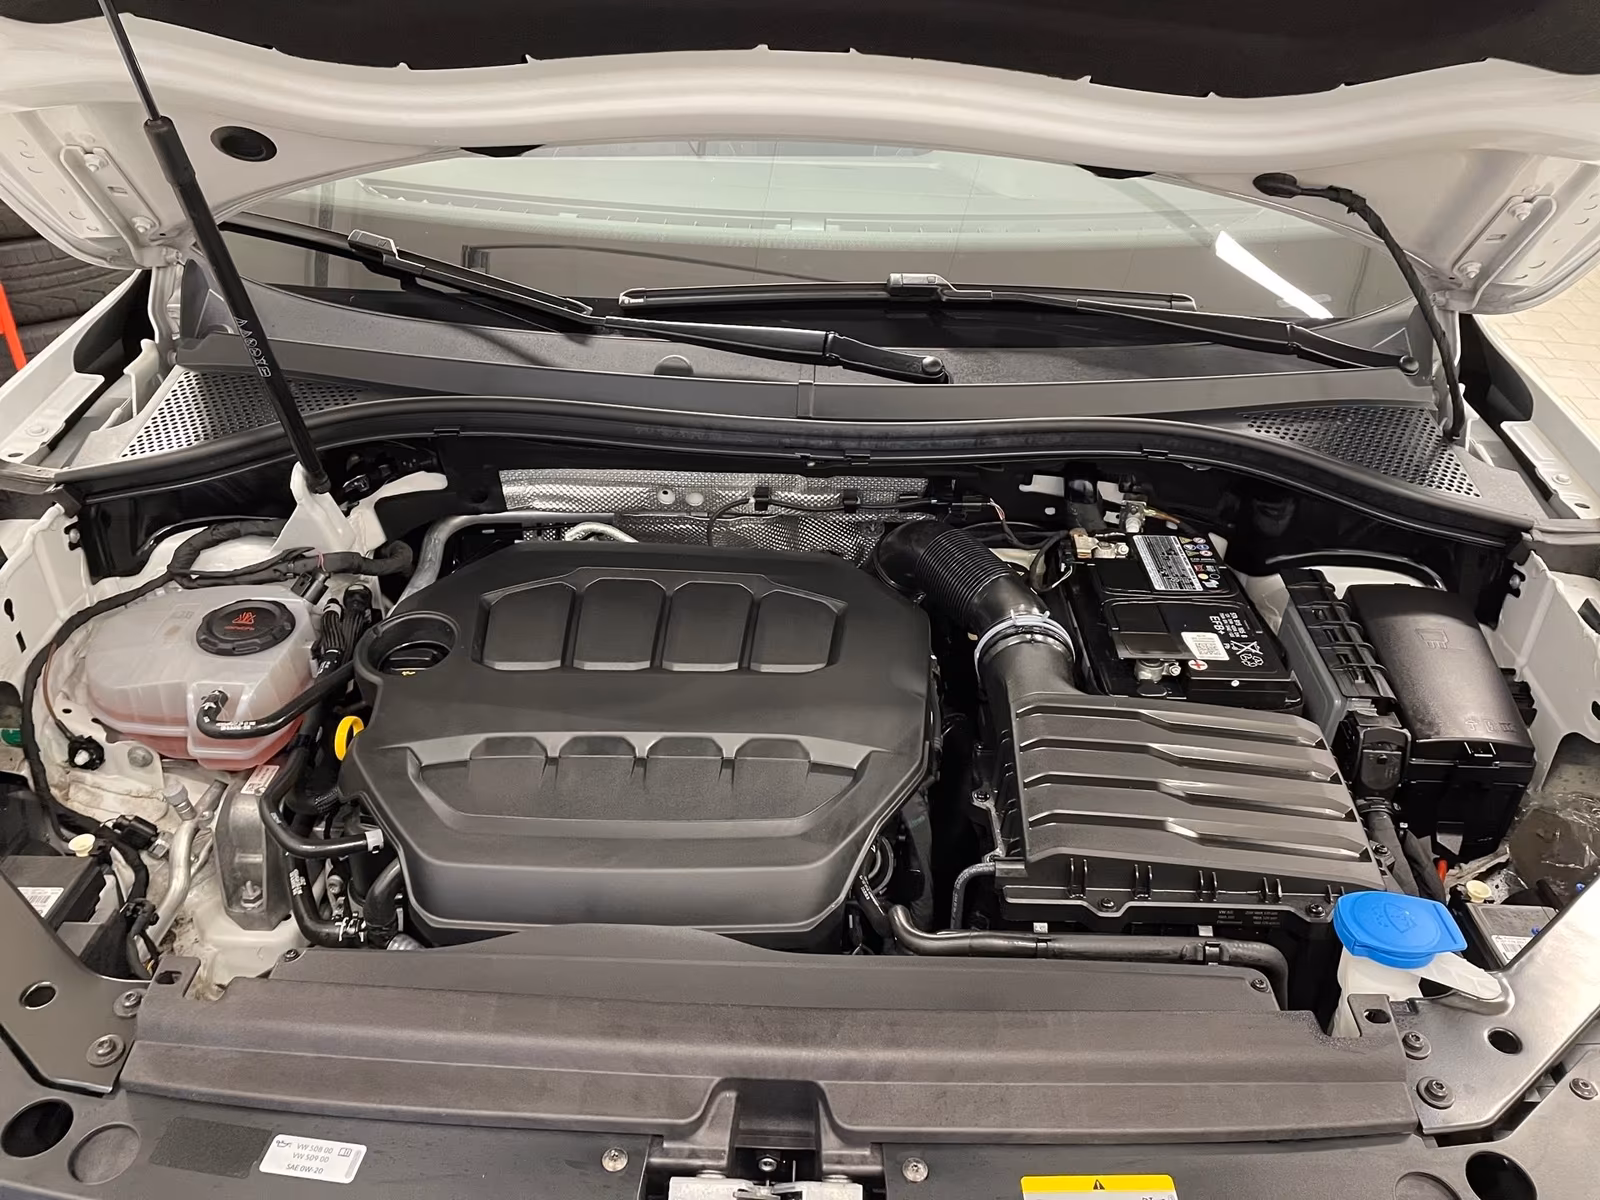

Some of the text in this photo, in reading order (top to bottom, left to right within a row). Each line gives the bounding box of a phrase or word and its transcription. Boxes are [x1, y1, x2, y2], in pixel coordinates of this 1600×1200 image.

[1209, 615, 1225, 635] EFB+
[296, 1143, 308, 1151] VW
[309, 1144, 322, 1153] 508
[305, 1153, 319, 1162] 509
[286, 1163, 324, 1174] SAE 0W-20
